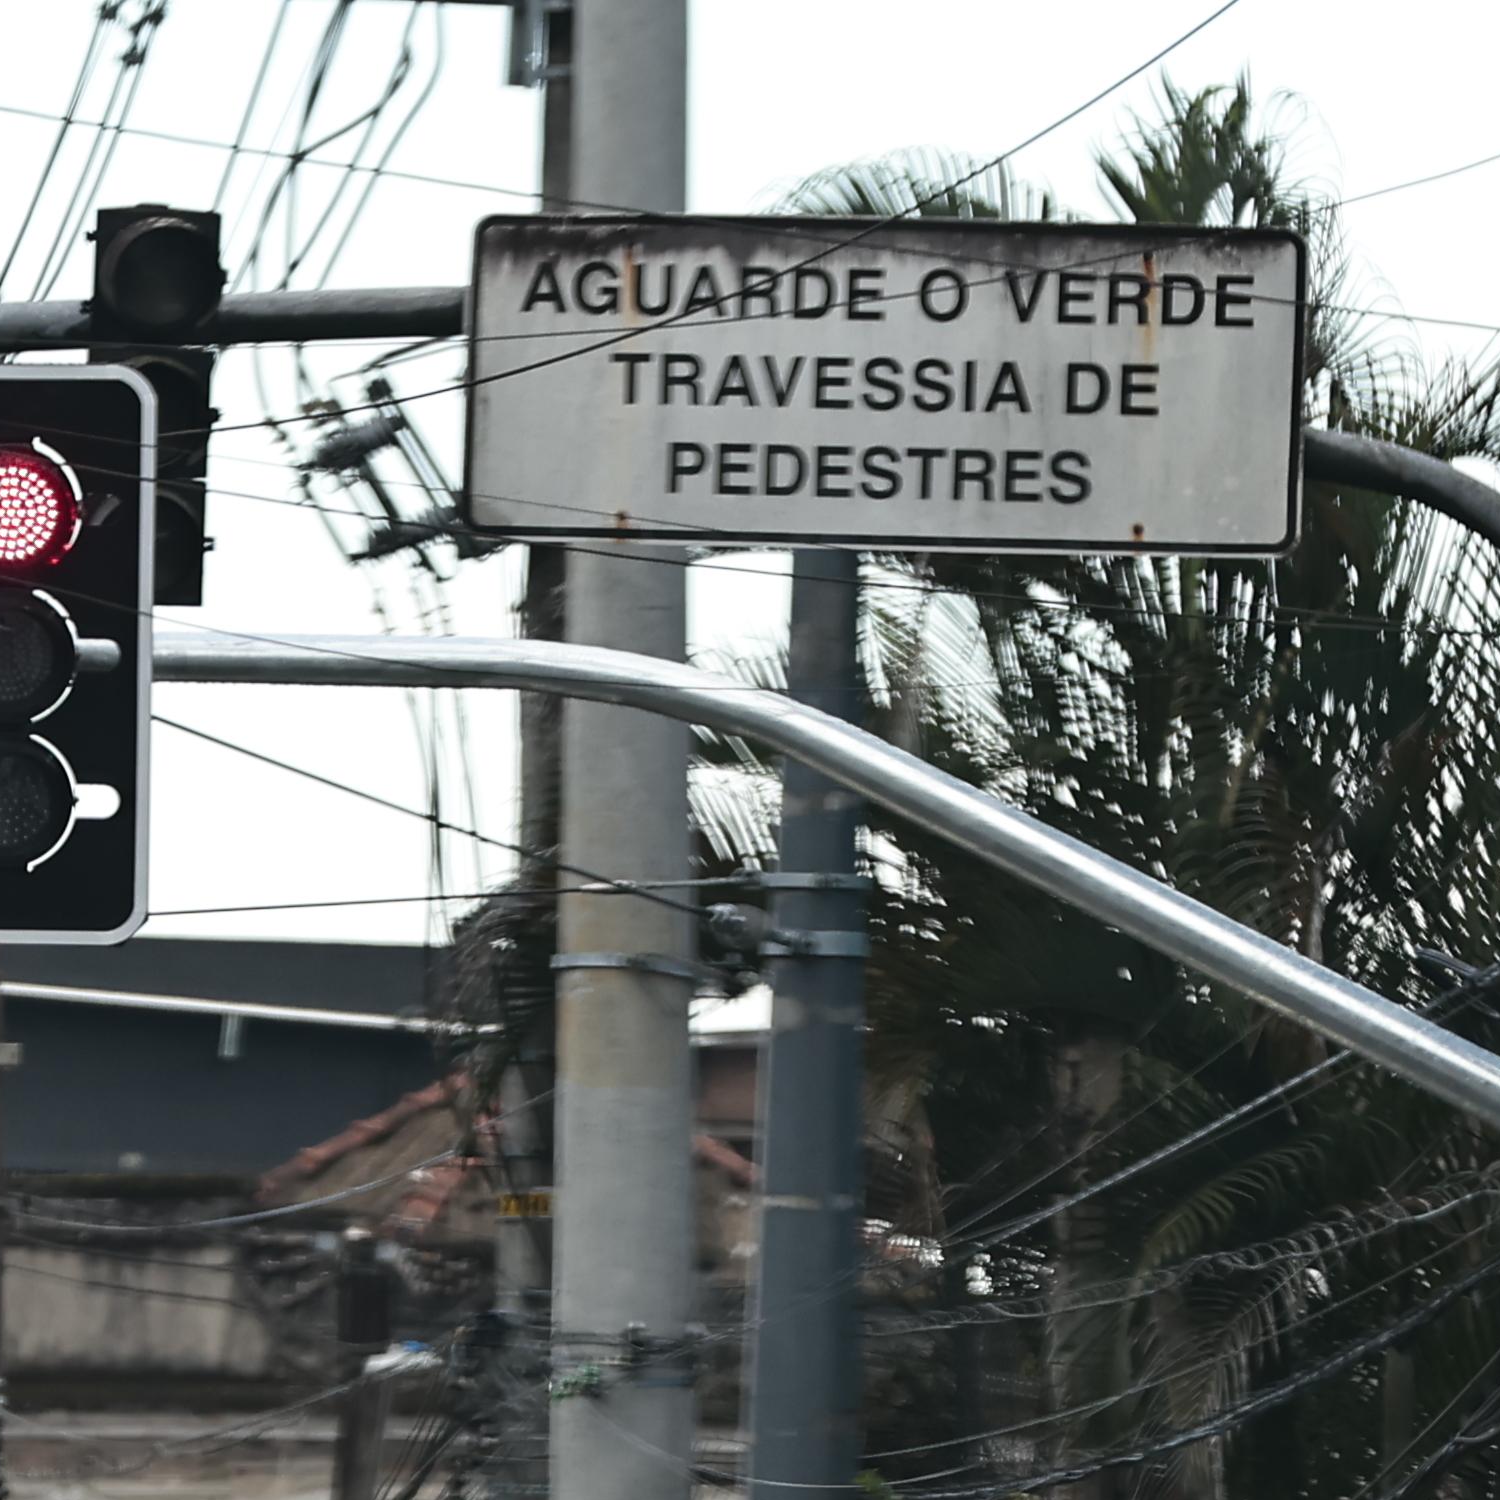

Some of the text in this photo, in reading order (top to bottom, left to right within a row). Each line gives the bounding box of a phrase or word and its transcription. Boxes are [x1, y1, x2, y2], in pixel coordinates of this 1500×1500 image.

[521, 260, 1254, 328] AGUARDE O VERDE
[610, 352, 1159, 416] TRAVESSIA DE
[666, 441, 1092, 504] PEDESTRES
